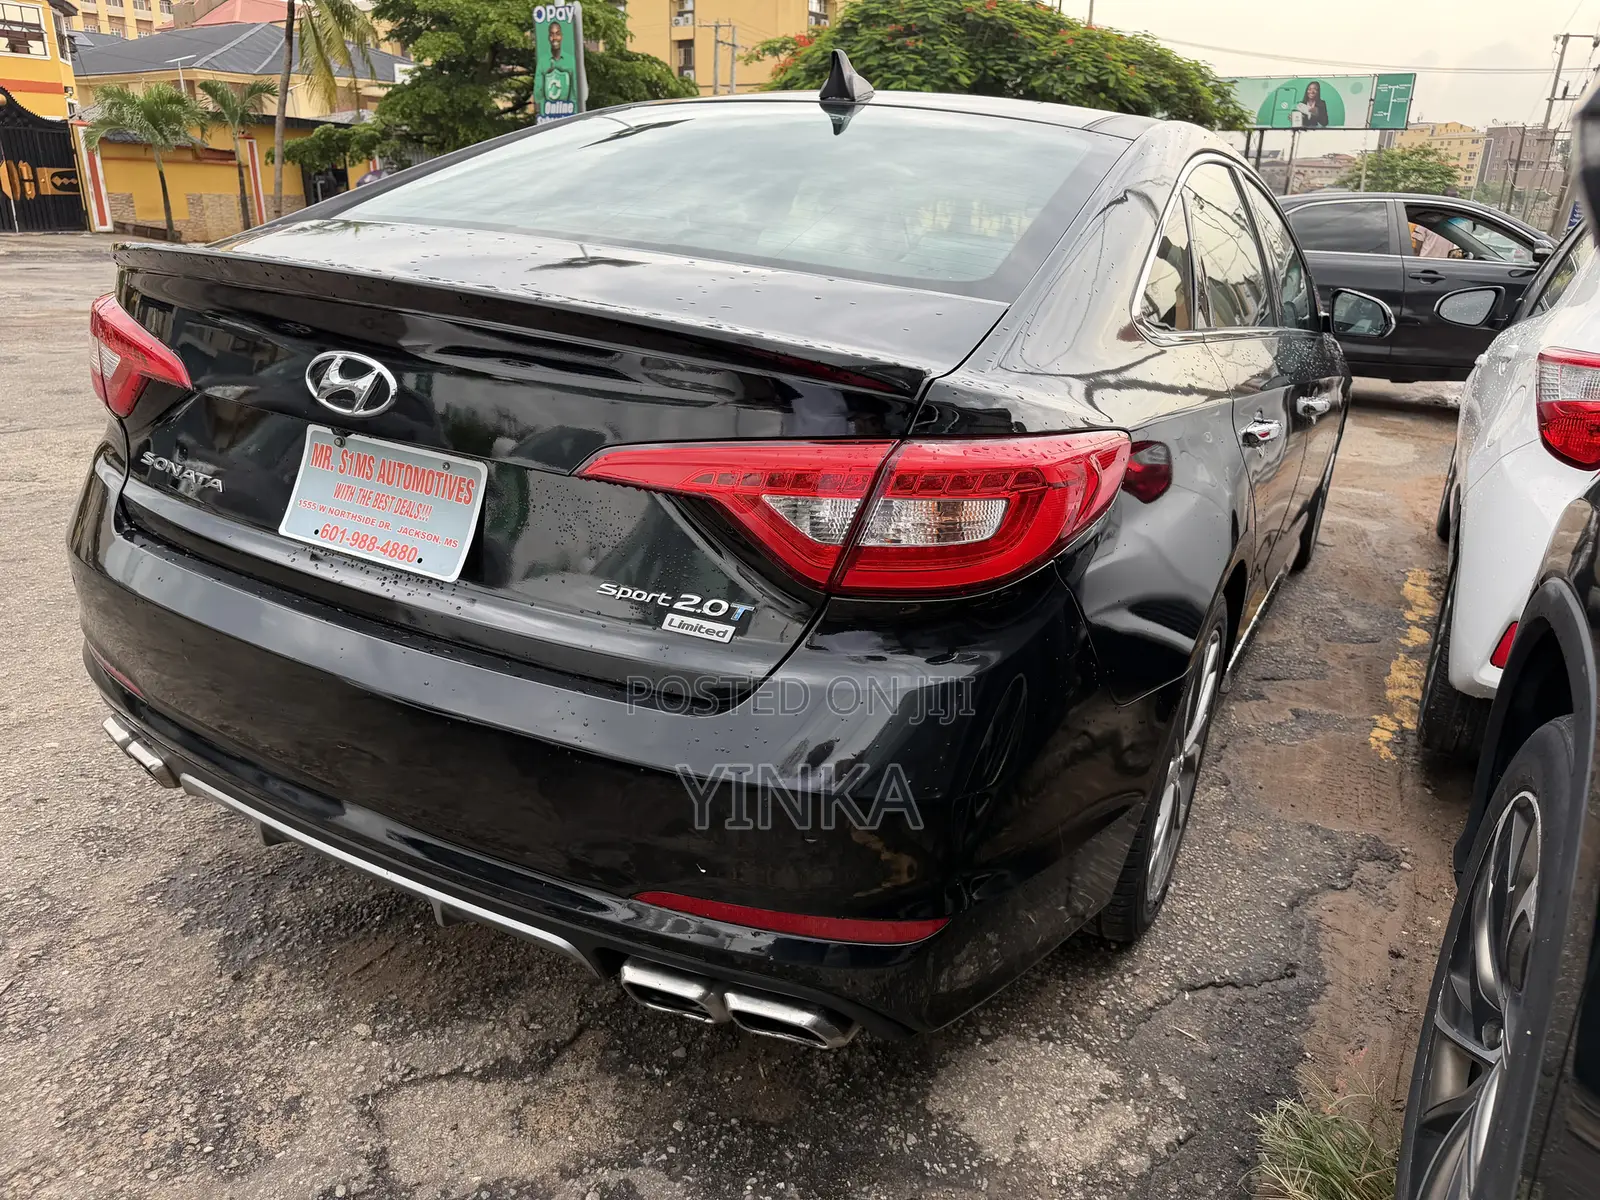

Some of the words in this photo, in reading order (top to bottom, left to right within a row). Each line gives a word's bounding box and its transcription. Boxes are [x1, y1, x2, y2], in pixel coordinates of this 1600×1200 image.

[533, 5, 575, 23] OPay
[140, 451, 223, 493] SONATA
[310, 443, 334, 472] MR.
[376, 458, 475, 505] AUTOMOTIVES
[333, 482, 356, 502] WITH
[356, 488, 374, 507] THE
[372, 492, 396, 512] BEST
[393, 498, 433, 522] DEALS!!!
[298, 499, 317, 511] 1555
[318, 504, 327, 512] W
[327, 507, 376, 526] NORTHSIDE
[378, 520, 392, 531] DR.
[397, 525, 441, 545] JACKSON,
[443, 537, 459, 549] MS
[320, 523, 418, 564] 601-988-4880
[596, 583, 673, 607] Sport
[672, 593, 756, 622] 2.0T
[667, 618, 729, 639] Limited
